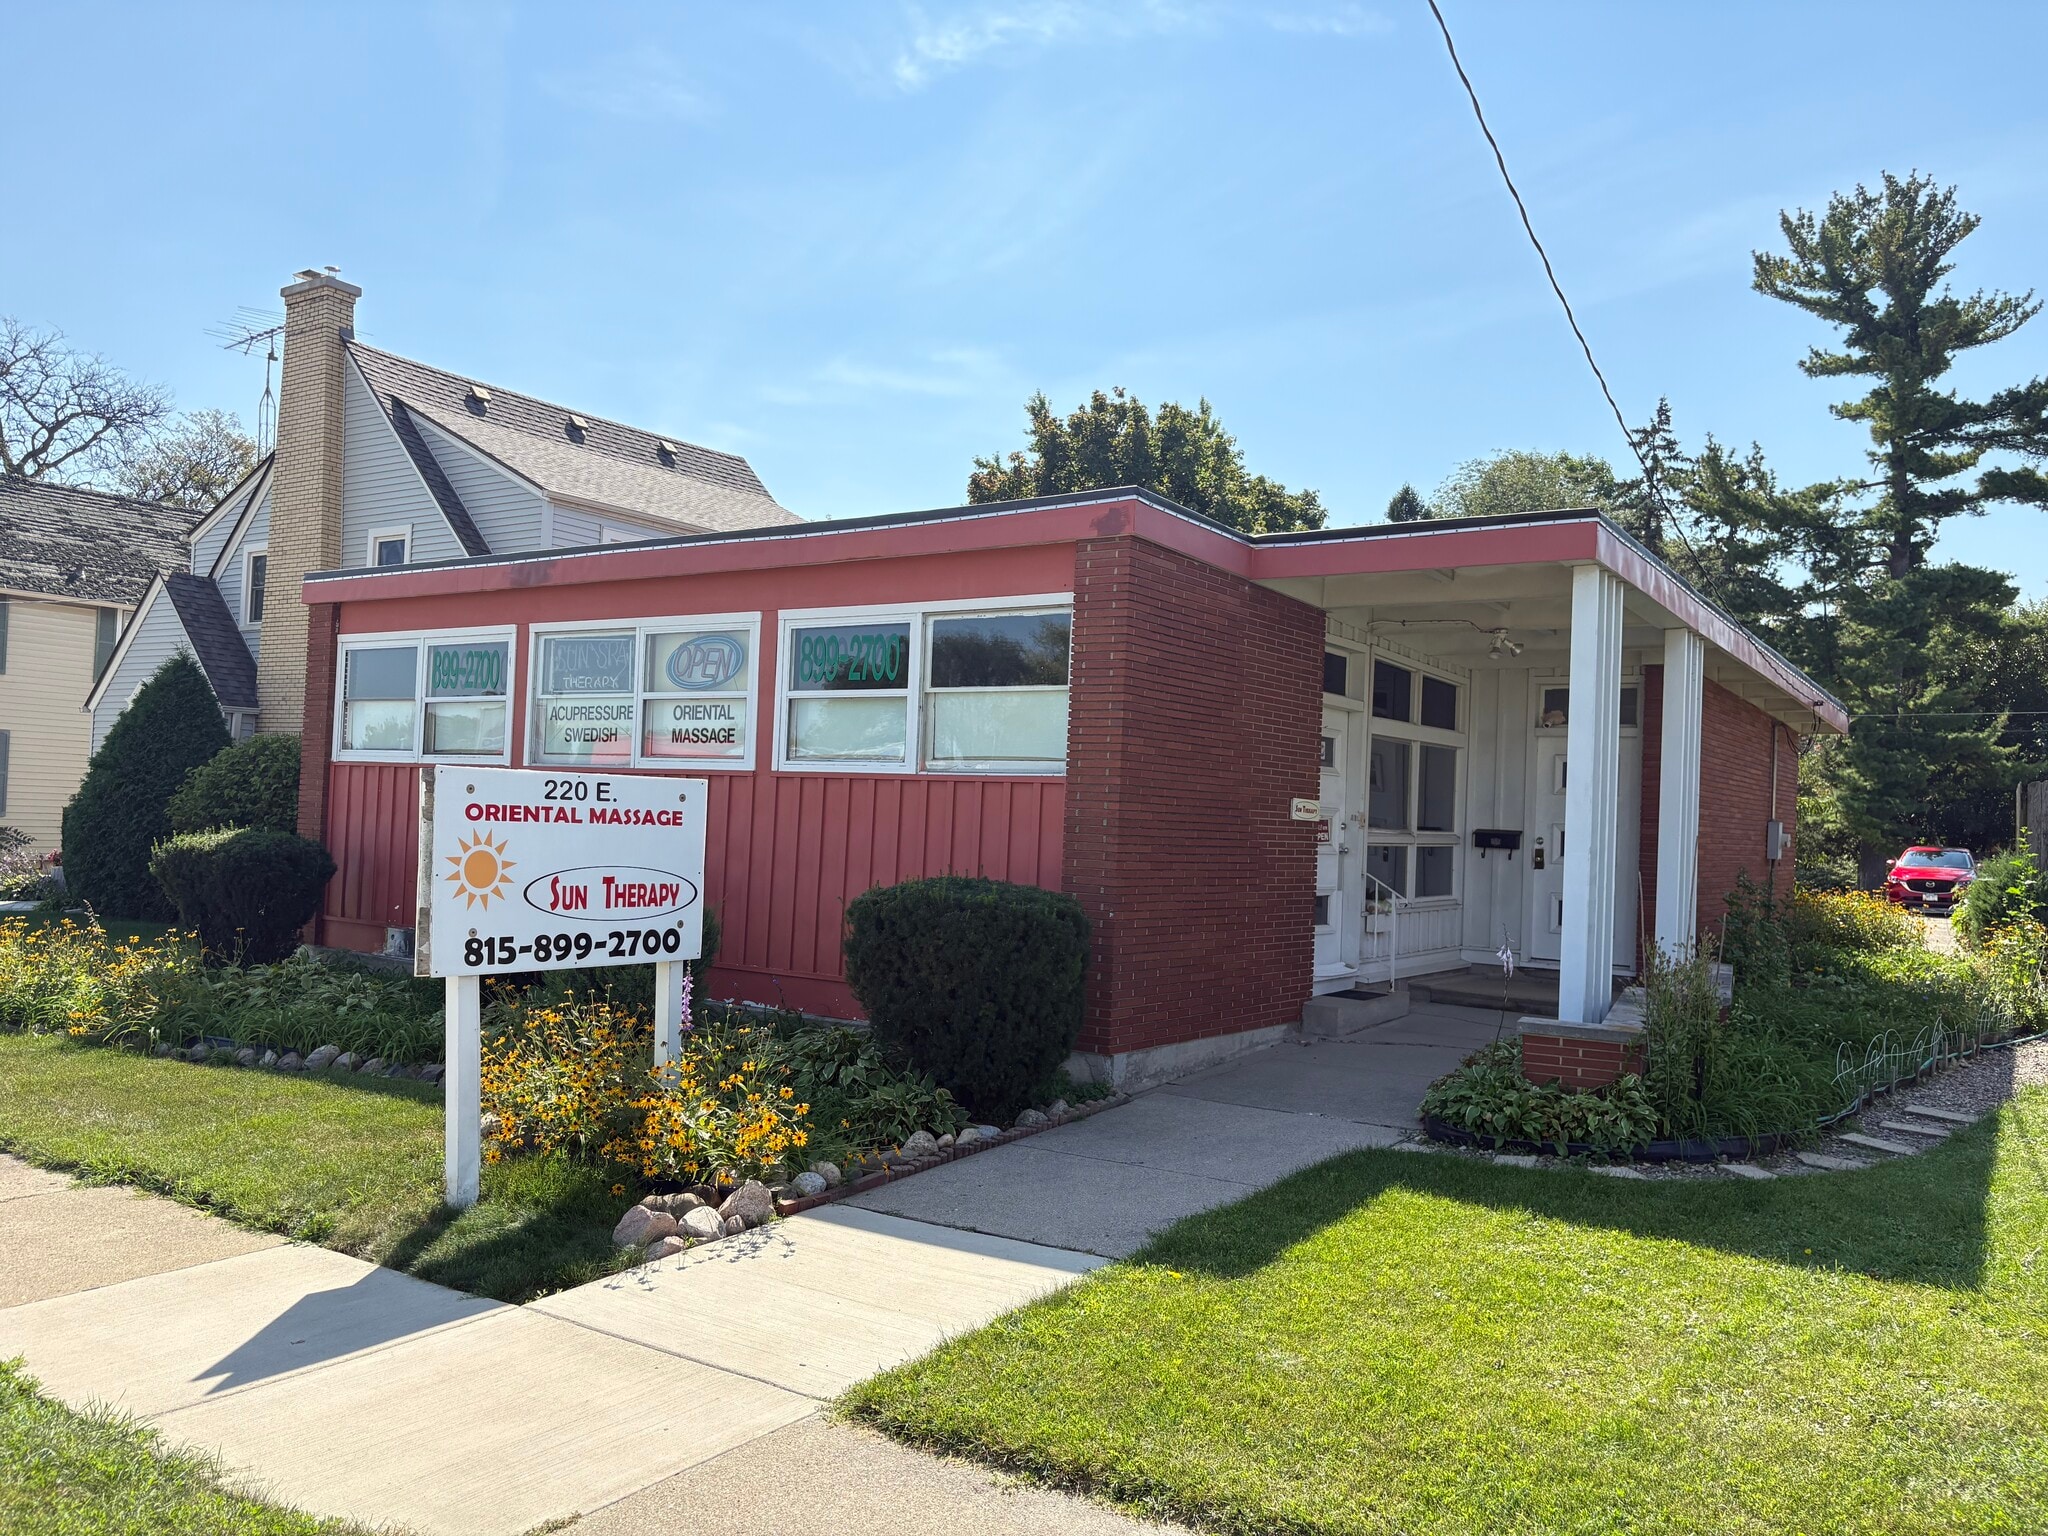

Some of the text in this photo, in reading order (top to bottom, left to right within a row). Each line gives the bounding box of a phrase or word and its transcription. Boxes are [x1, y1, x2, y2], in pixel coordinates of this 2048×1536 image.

[674, 645, 734, 681] OPEN
[801, 633, 900, 682] 899-2700
[432, 650, 500, 689] 899-2700
[562, 674, 619, 689] THERAPY
[550, 705, 633, 721] ACUPRESSURE
[673, 705, 735, 721] ORIENTAL
[564, 727, 618, 743] SWEDISH
[671, 728, 736, 744] MASSAGE
[544, 780, 618, 802] 220 E.
[465, 803, 684, 827] ORIENTAL MASSAGE
[549, 875, 680, 912] SUN THERAPY
[464, 928, 681, 967] 815-899-2700
